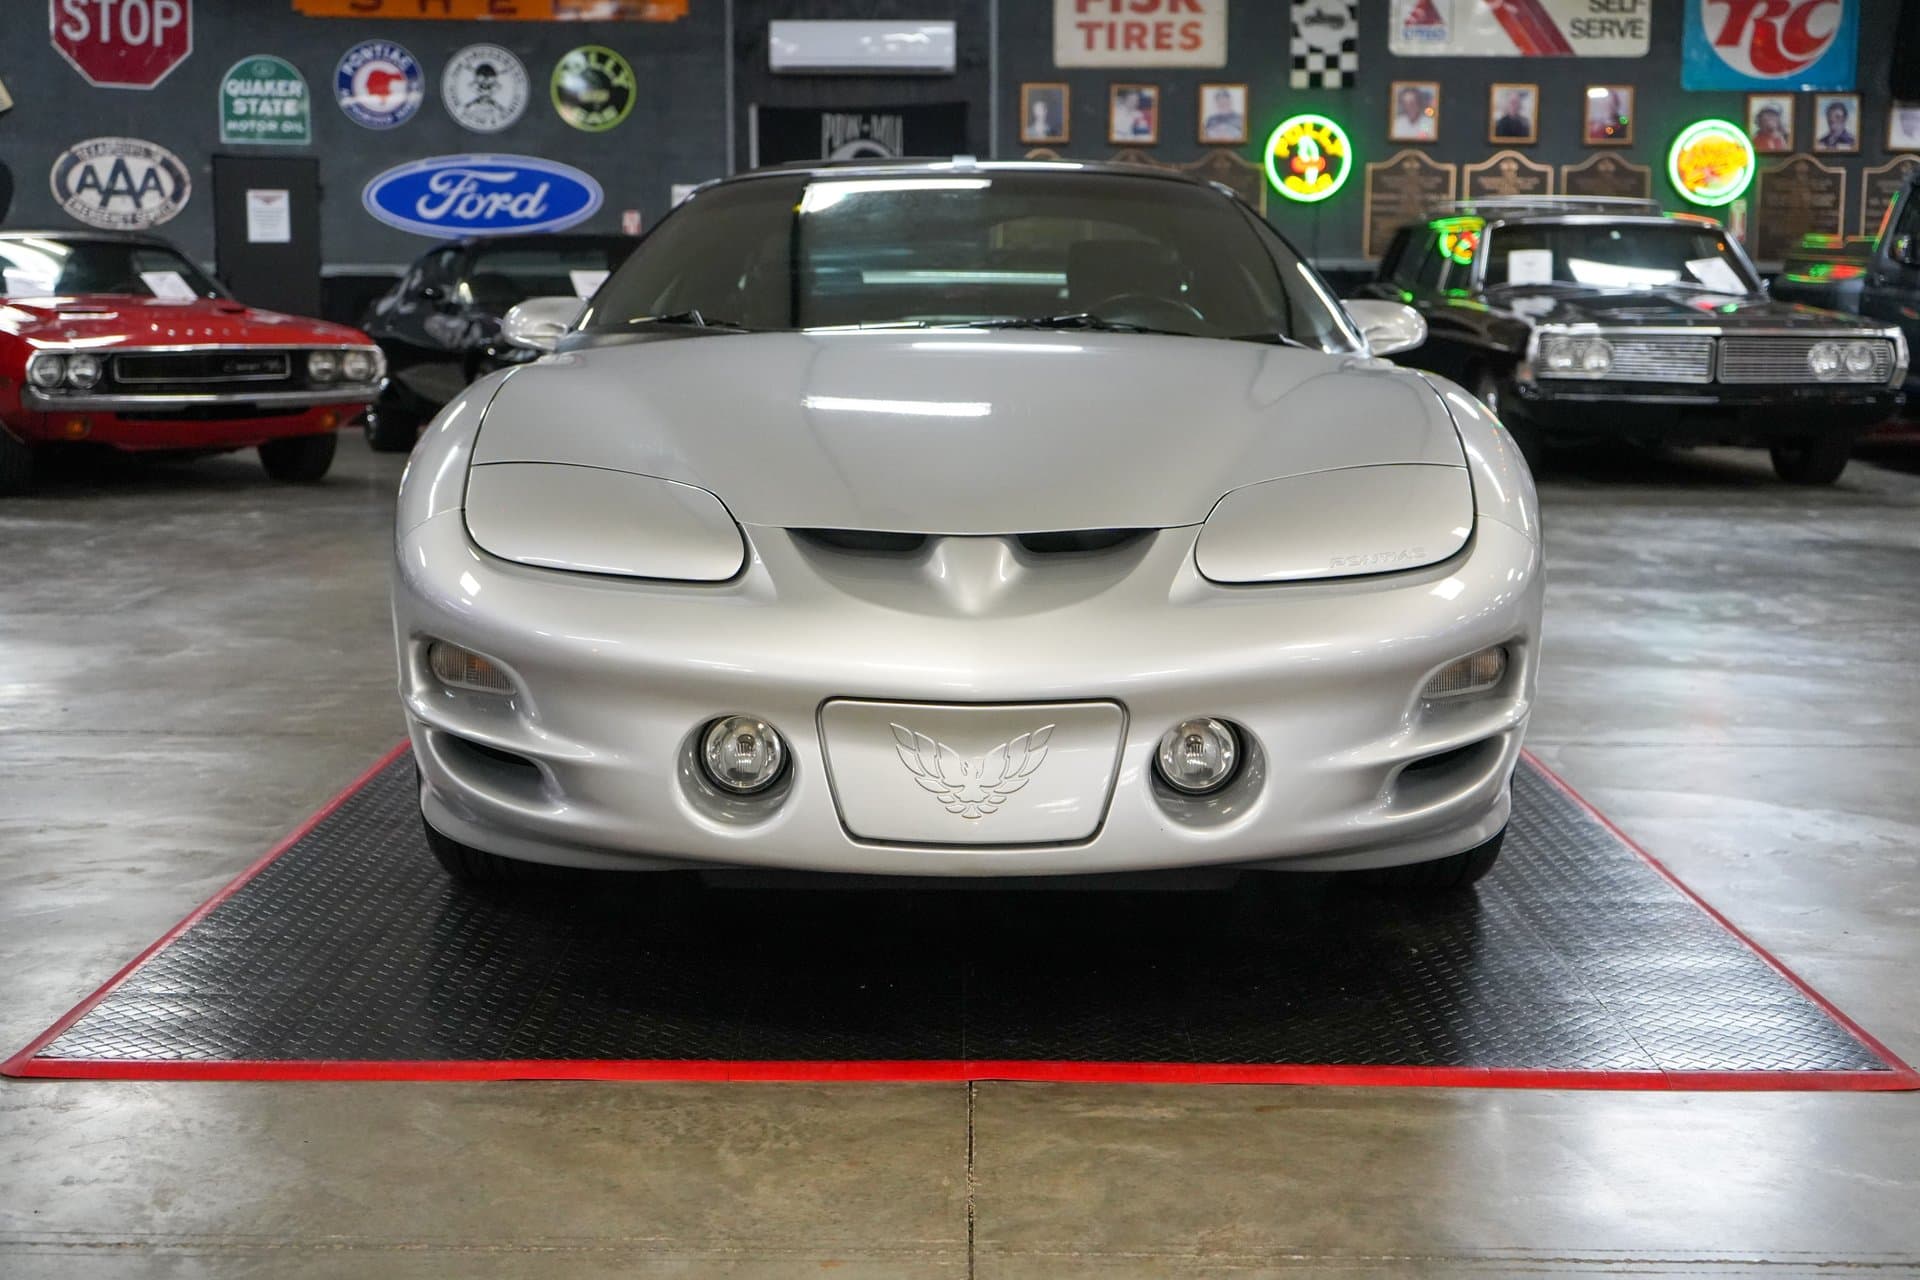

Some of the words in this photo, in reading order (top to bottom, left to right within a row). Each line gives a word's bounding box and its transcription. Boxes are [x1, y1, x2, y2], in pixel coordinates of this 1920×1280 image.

[61, 0, 182, 47] STOP
[1075, 20, 1205, 52] TIRES
[1570, 17, 1645, 39] SERVE
[1706, 0, 1841, 75] RC
[342, 44, 416, 75] PONTIAC
[226, 79, 303, 97] QUAKER
[232, 98, 299, 116] STATE
[226, 120, 279, 133] MOTOR
[281, 121, 305, 134] OIL
[1274, 122, 1345, 157] POLLY
[76, 156, 166, 209] AAA
[416, 168, 550, 220] Ford
[1328, 547, 1427, 569] PONTIAC
